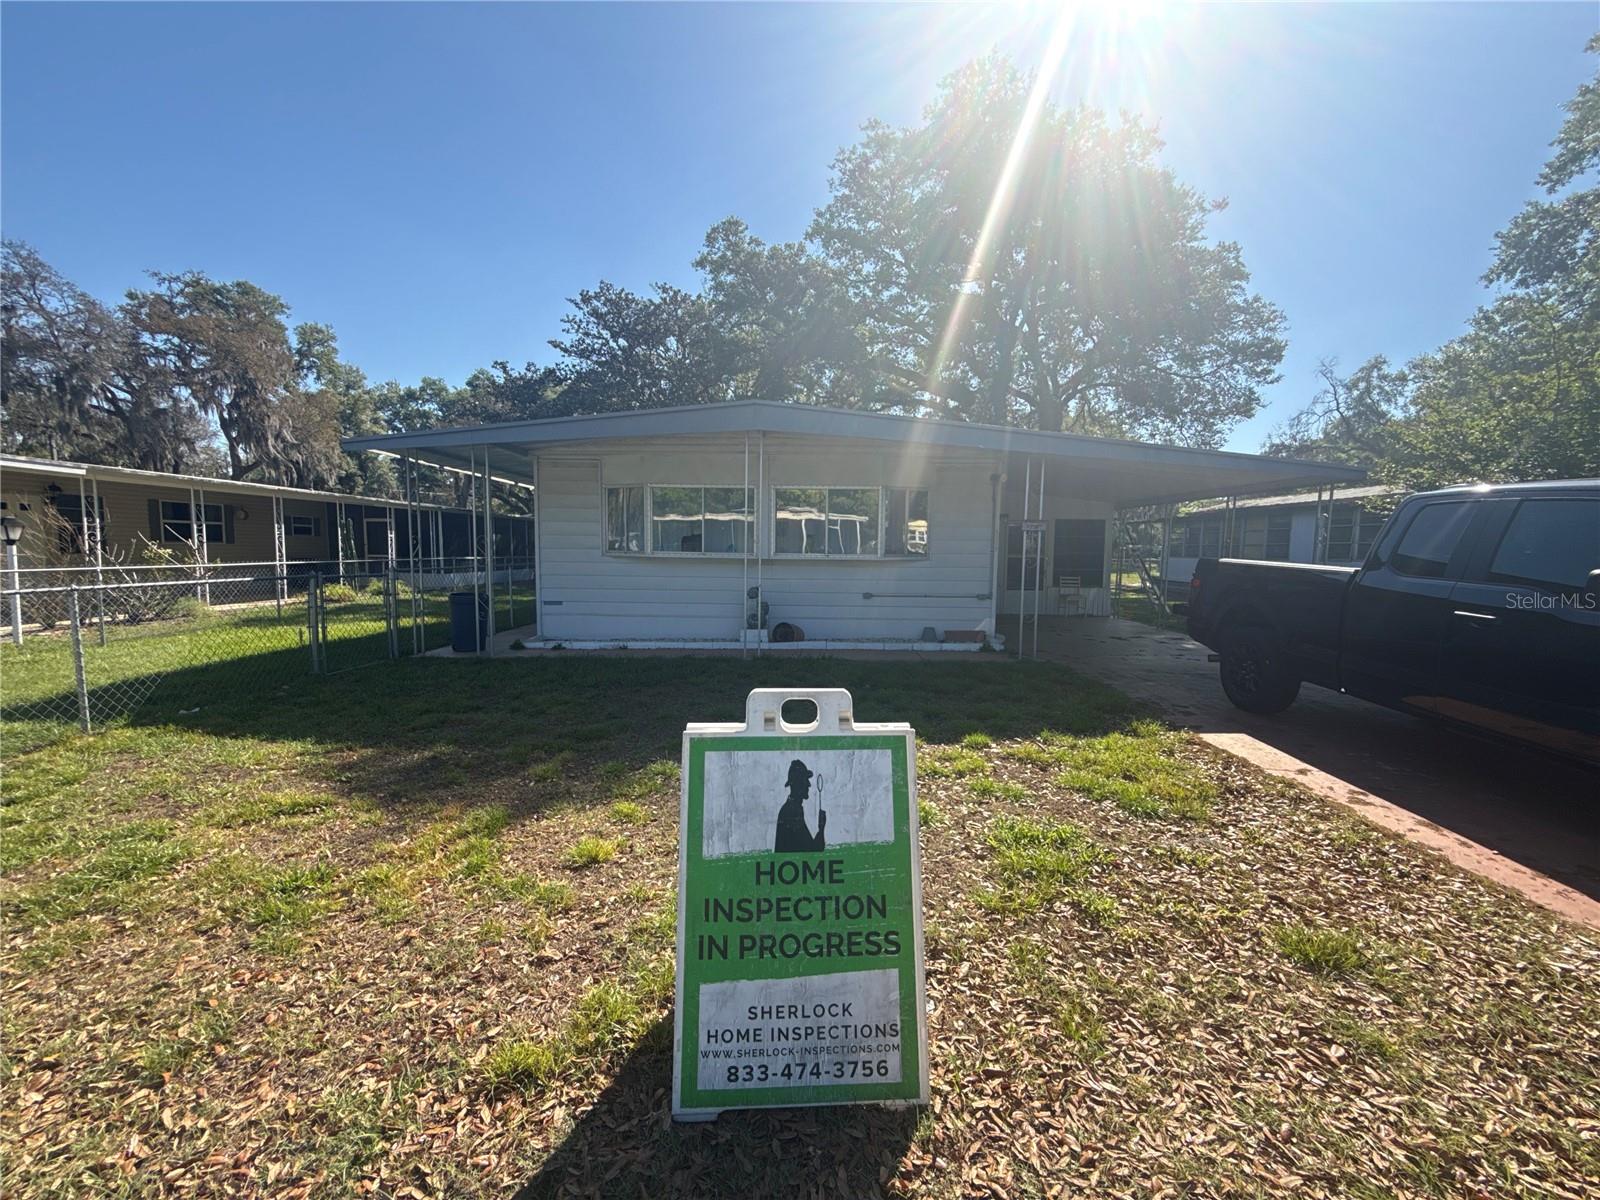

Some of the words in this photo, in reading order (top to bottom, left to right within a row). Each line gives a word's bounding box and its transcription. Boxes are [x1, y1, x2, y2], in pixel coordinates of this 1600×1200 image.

[755, 859, 845, 886] HOME
[703, 894, 887, 923] INSPECTION
[698, 934, 728, 960] IN
[739, 931, 901, 960] PROGRESS
[747, 1002, 853, 1020] SHERLOCK
[706, 1028, 763, 1044] HOME
[770, 1023, 900, 1042] INSPECTIONS
[700, 1043, 901, 1059] WWW.SHERLOCK-INSPECTIONS.COM
[727, 1060, 889, 1082] 833-474-3756
